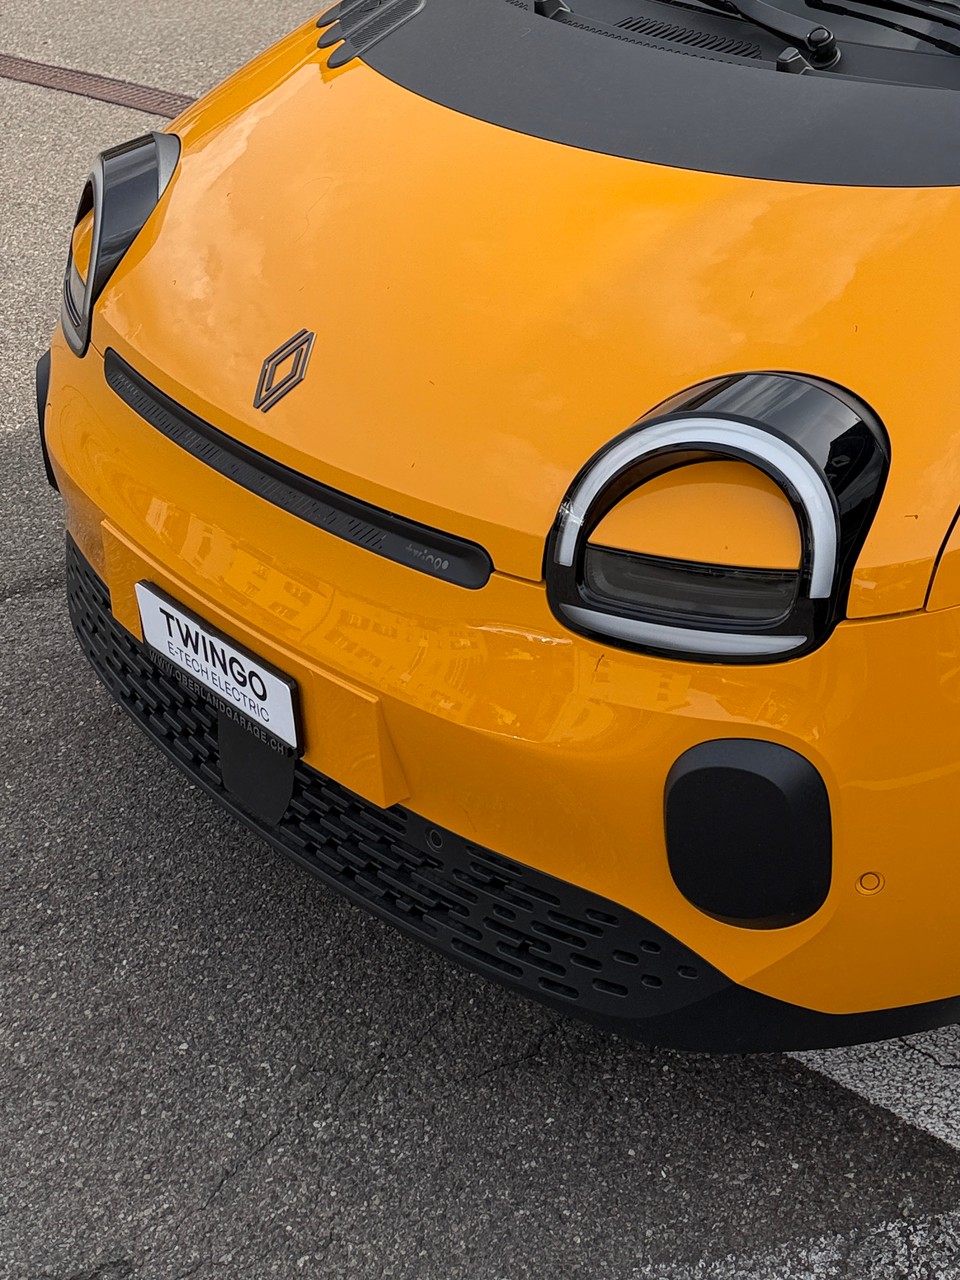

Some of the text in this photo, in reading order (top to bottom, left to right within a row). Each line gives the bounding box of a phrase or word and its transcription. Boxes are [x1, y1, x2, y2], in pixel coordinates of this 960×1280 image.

[159, 607, 268, 702] TWINGO
[167, 640, 270, 723] E-TECH ELECTRIC
[150, 651, 285, 755] WWW.OBERLANDGARAGE.CH
